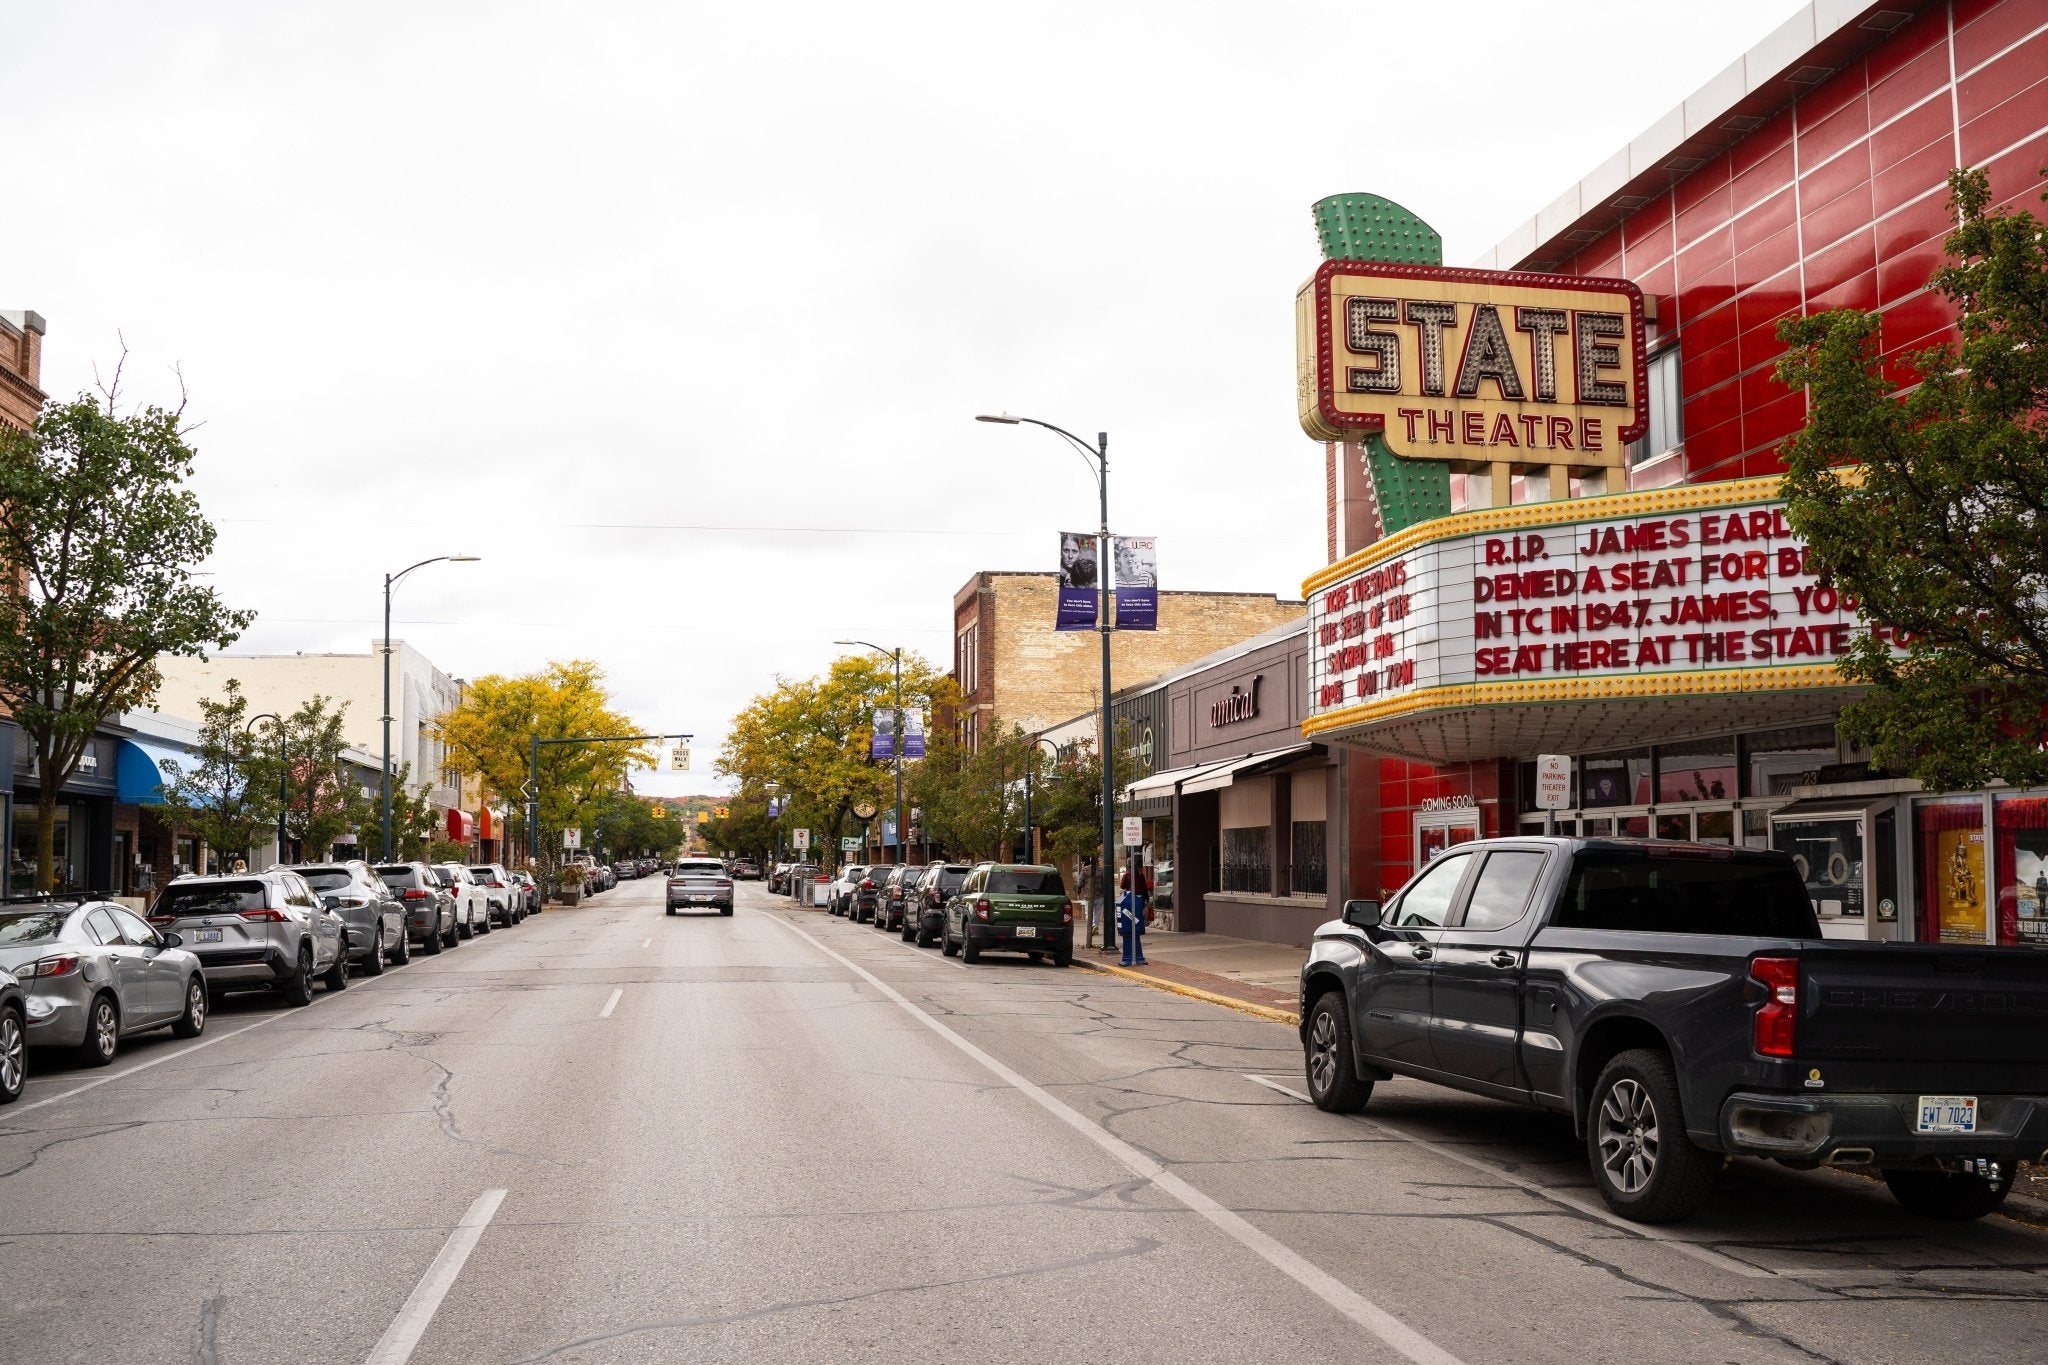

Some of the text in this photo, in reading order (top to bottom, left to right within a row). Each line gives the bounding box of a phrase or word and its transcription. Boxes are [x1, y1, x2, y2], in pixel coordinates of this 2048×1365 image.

[1343, 296, 1628, 405] STATE
[1398, 408, 1602, 451] THEATRE
[1485, 508, 1791, 567] R.I.P. JAMES EARL
[1350, 560, 1406, 604] TUESDAYS
[1474, 568, 1578, 604] DENIED
[1582, 565, 1606, 594] A
[1610, 556, 1692, 592] SEAT
[1701, 550, 1768, 585] FOR
[1319, 593, 1410, 648] THE SEED OF THE
[1474, 611, 1502, 639] IN
[1508, 608, 1543, 637] TC
[1551, 604, 1579, 634] IN
[1586, 598, 1653, 631] 1947.
[1660, 589, 1778, 626] JAMES,
[1327, 633, 1393, 675] SACRED FIG
[1475, 643, 1547, 675] SEAT
[1553, 638, 1630, 671] HERE
[1635, 634, 1676, 667] AT
[1683, 630, 1747, 664] THE
[1751, 622, 1852, 660] STATE
[1386, 659, 1412, 690] 7PM
[1209, 673, 1263, 728] amical
[1542, 783, 1566, 791] THEATER
[1550, 762, 1559, 770] NO
[1422, 794, 1475, 812] COMING SOON
[1922, 1106, 1973, 1123] EWT 7023
